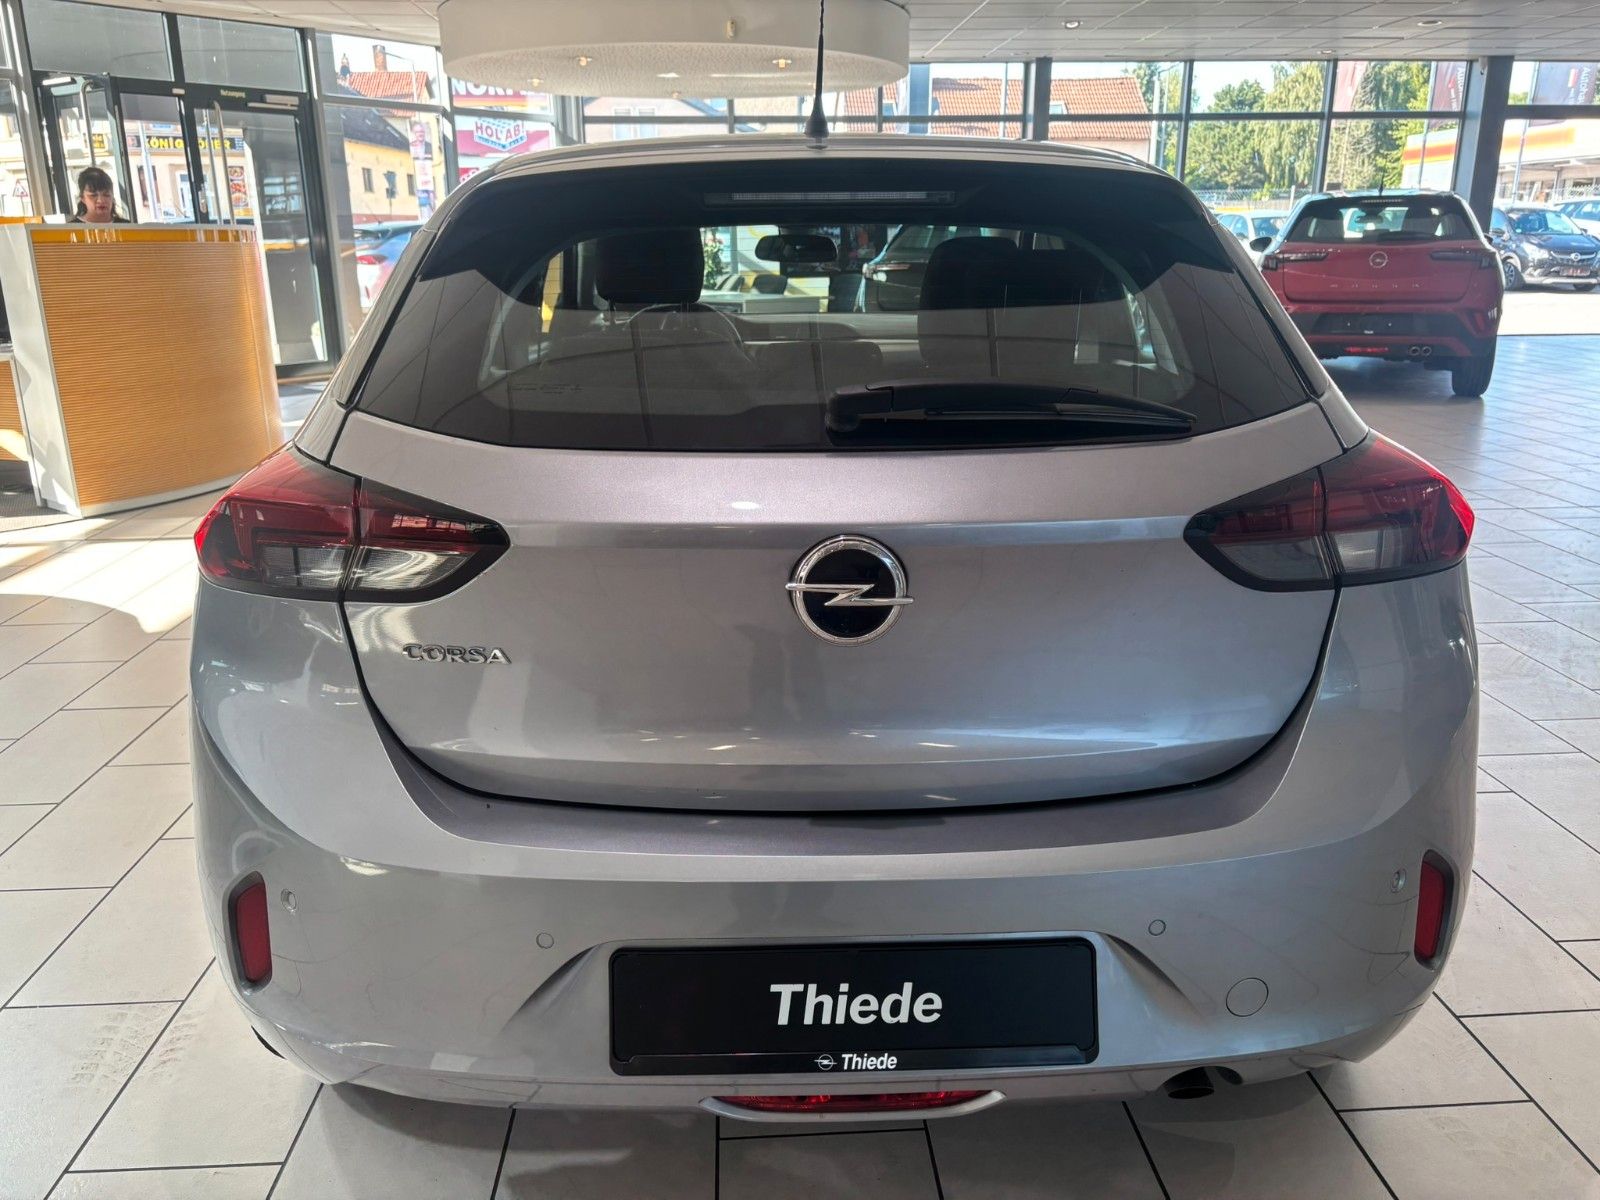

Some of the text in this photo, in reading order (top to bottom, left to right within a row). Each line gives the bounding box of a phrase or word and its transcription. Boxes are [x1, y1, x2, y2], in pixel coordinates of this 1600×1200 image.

[402, 643, 512, 664] CORSA
[770, 982, 943, 1026] Thiede
[841, 1053, 898, 1070] Thiede
